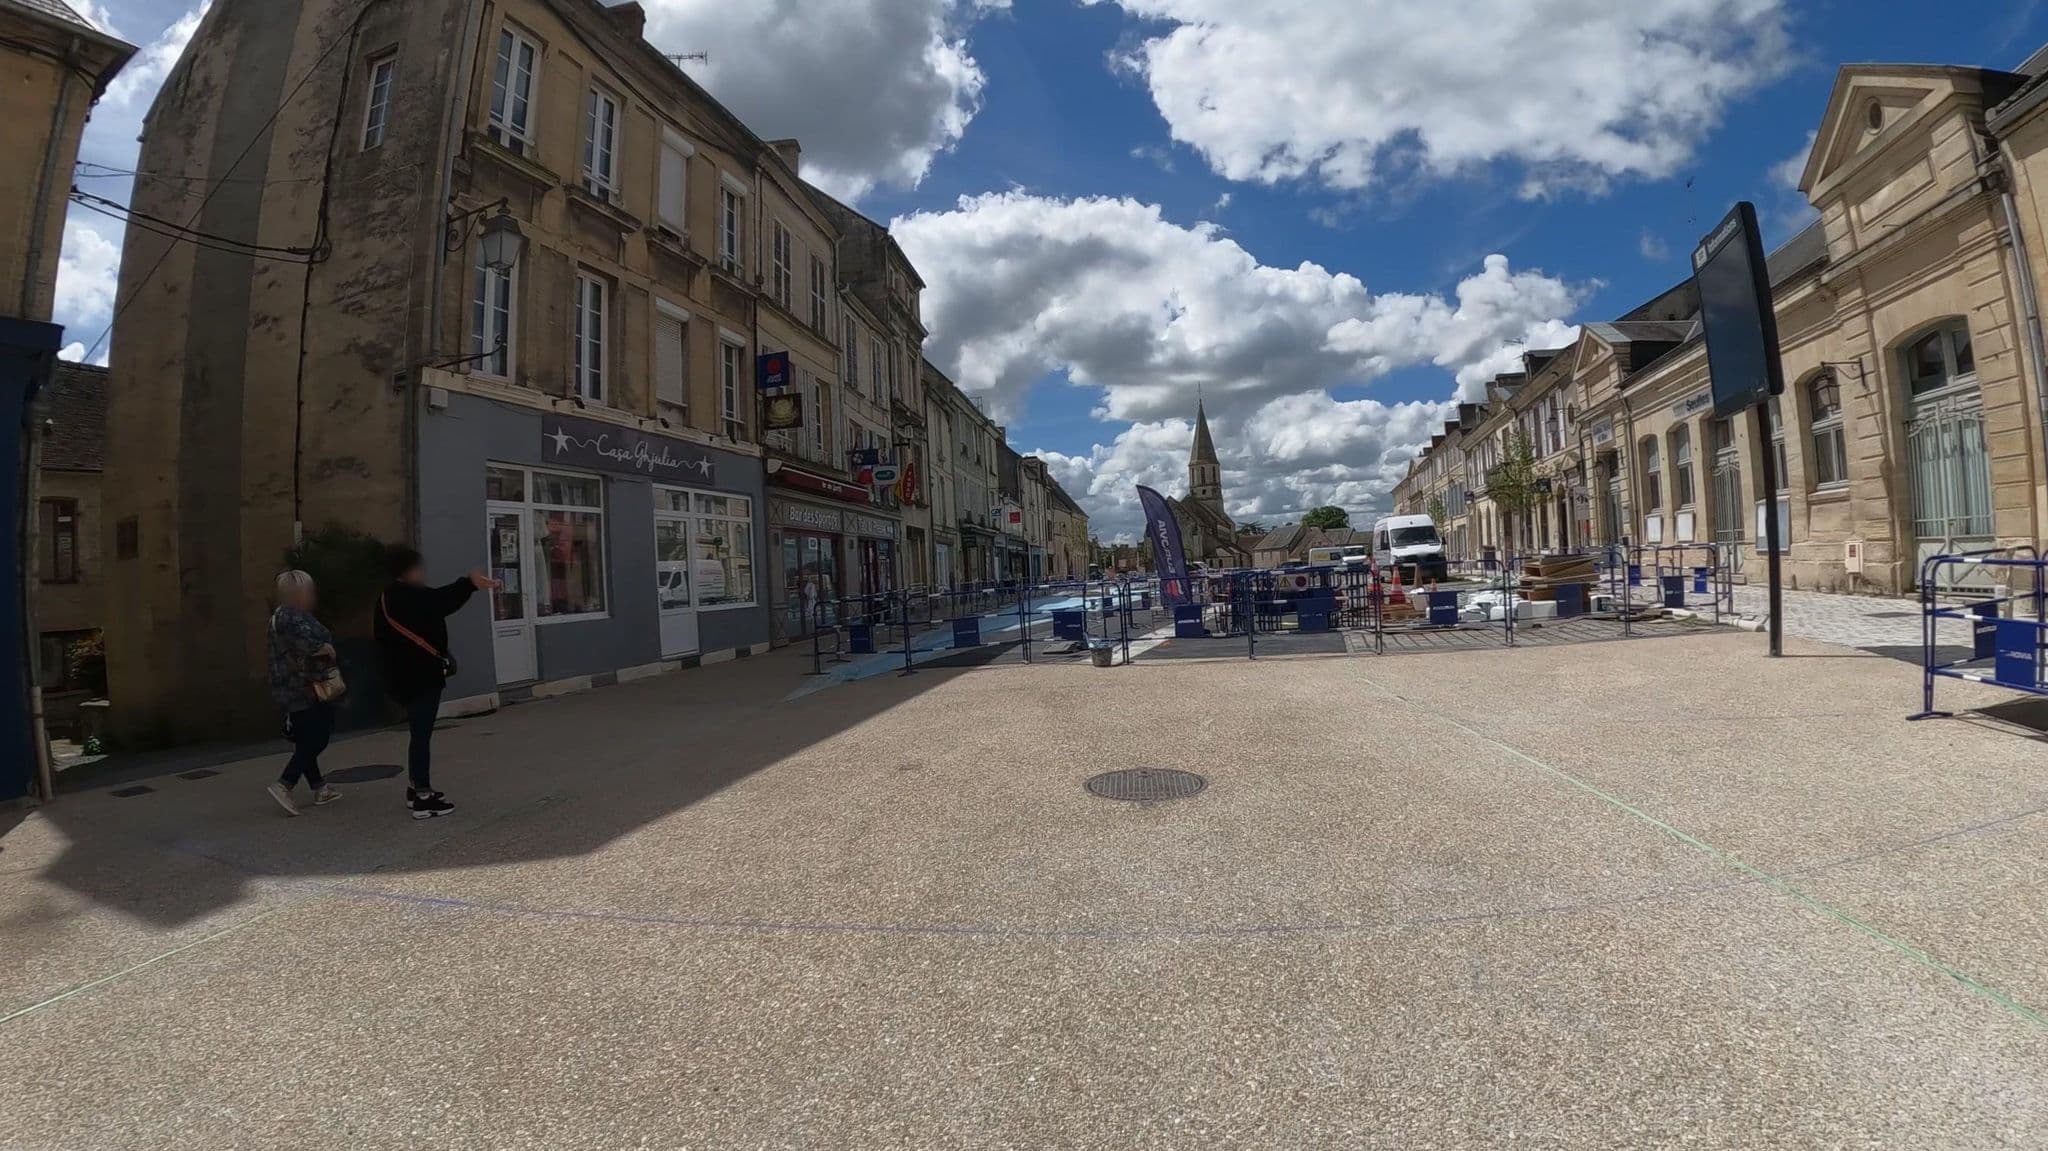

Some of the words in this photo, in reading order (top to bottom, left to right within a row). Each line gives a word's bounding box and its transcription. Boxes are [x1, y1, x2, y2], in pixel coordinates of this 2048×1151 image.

[596, 433, 634, 462] Casa
[634, 440, 679, 472] Ghjulia
[789, 506, 802, 521] Bar
